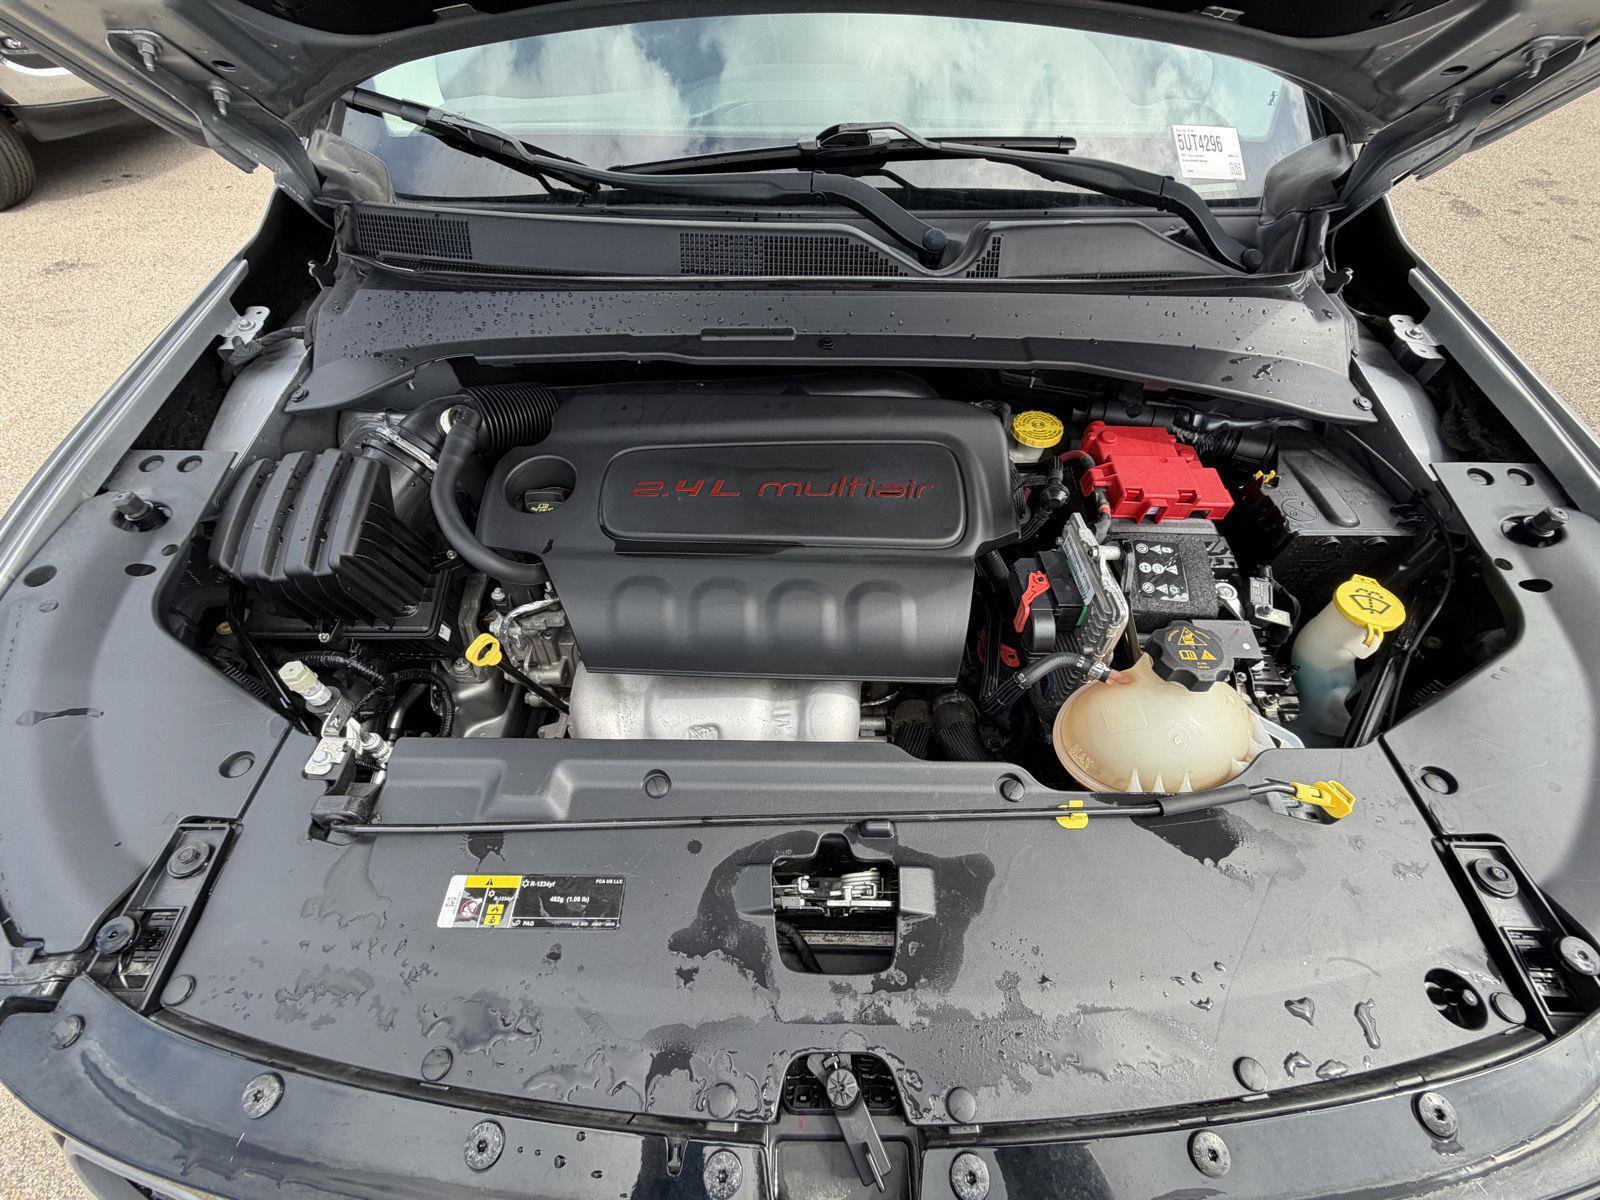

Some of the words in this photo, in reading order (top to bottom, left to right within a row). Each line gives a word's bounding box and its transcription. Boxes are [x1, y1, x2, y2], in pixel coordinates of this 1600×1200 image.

[1177, 133, 1223, 152] 5UT4296
[629, 479, 742, 497] 2.4L
[757, 475, 936, 499] multiair
[530, 880, 556, 889] R-1234yf
